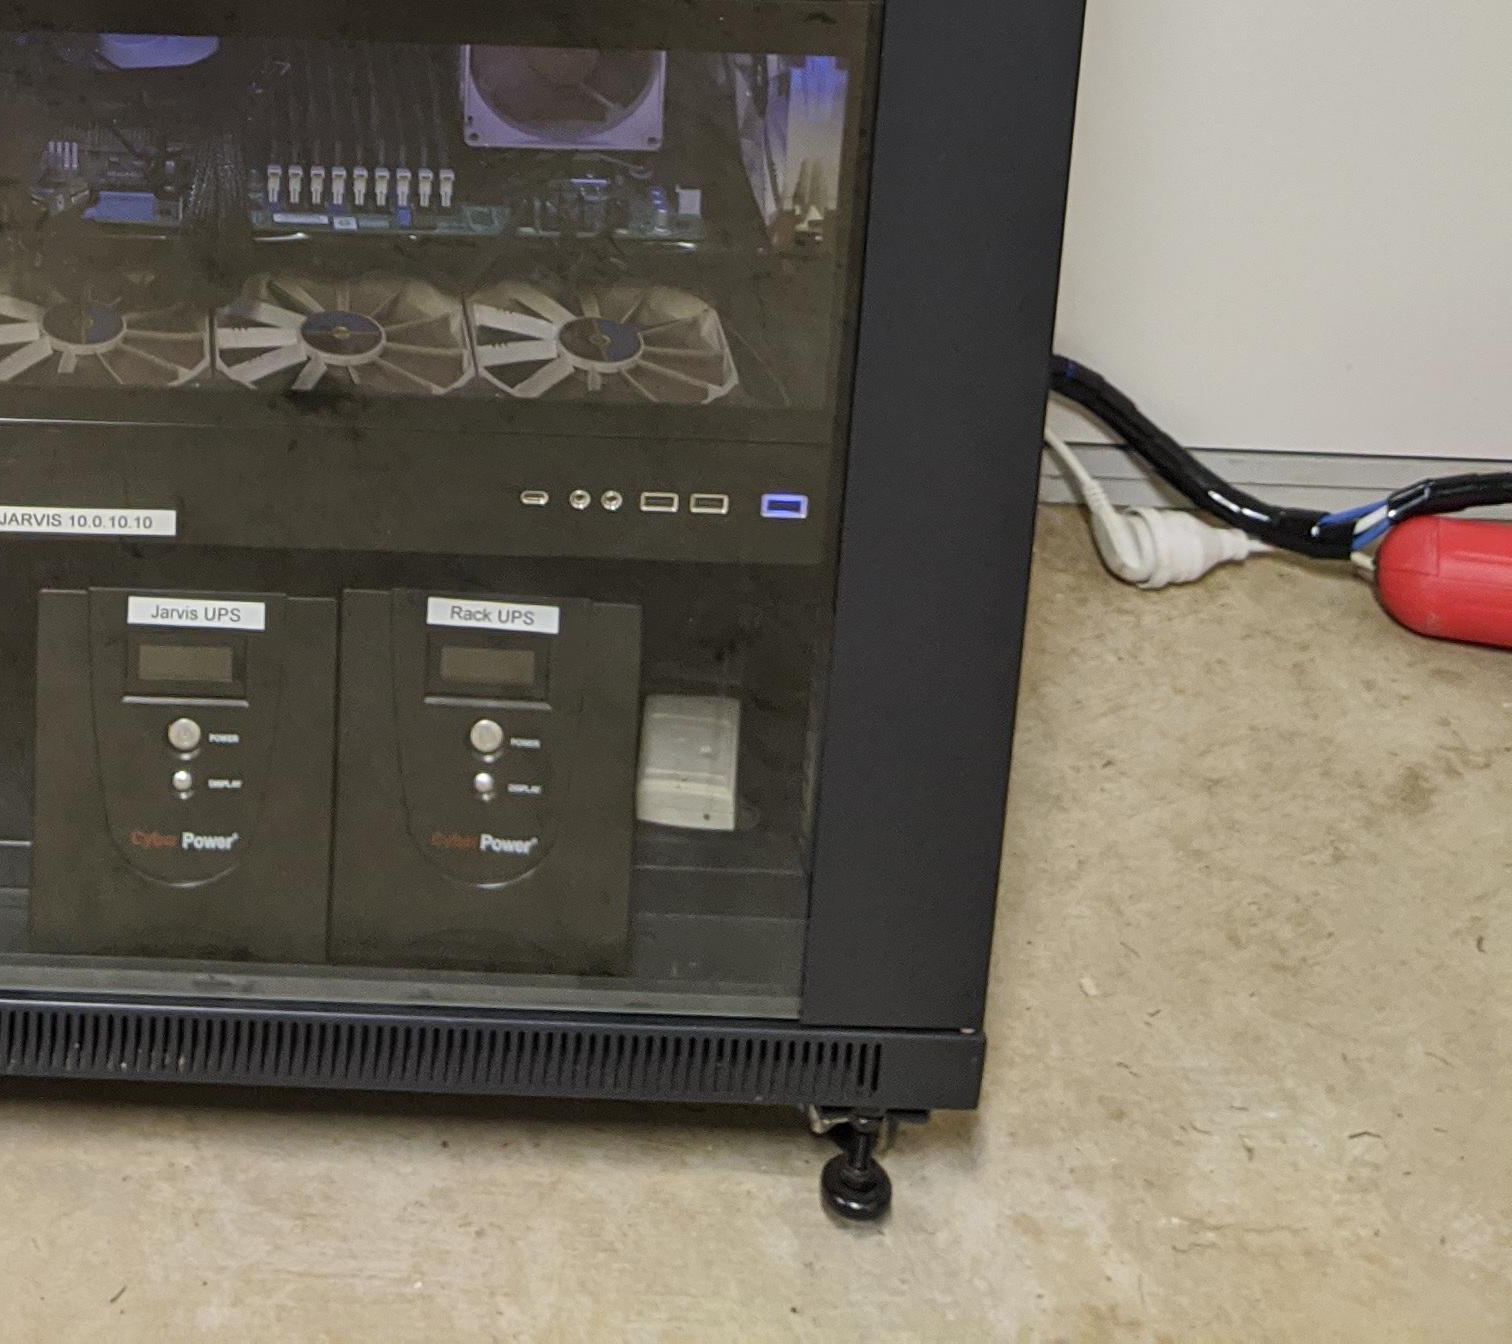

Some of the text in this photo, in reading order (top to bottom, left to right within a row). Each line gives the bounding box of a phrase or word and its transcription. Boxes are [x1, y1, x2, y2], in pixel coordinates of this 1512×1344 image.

[69, 514, 153, 530] 10.0.10.10
[151, 604, 242, 623] Jarvis UPS
[450, 605, 536, 626] Rack UPS
[182, 831, 235, 850] Power
[480, 833, 533, 854] Power
